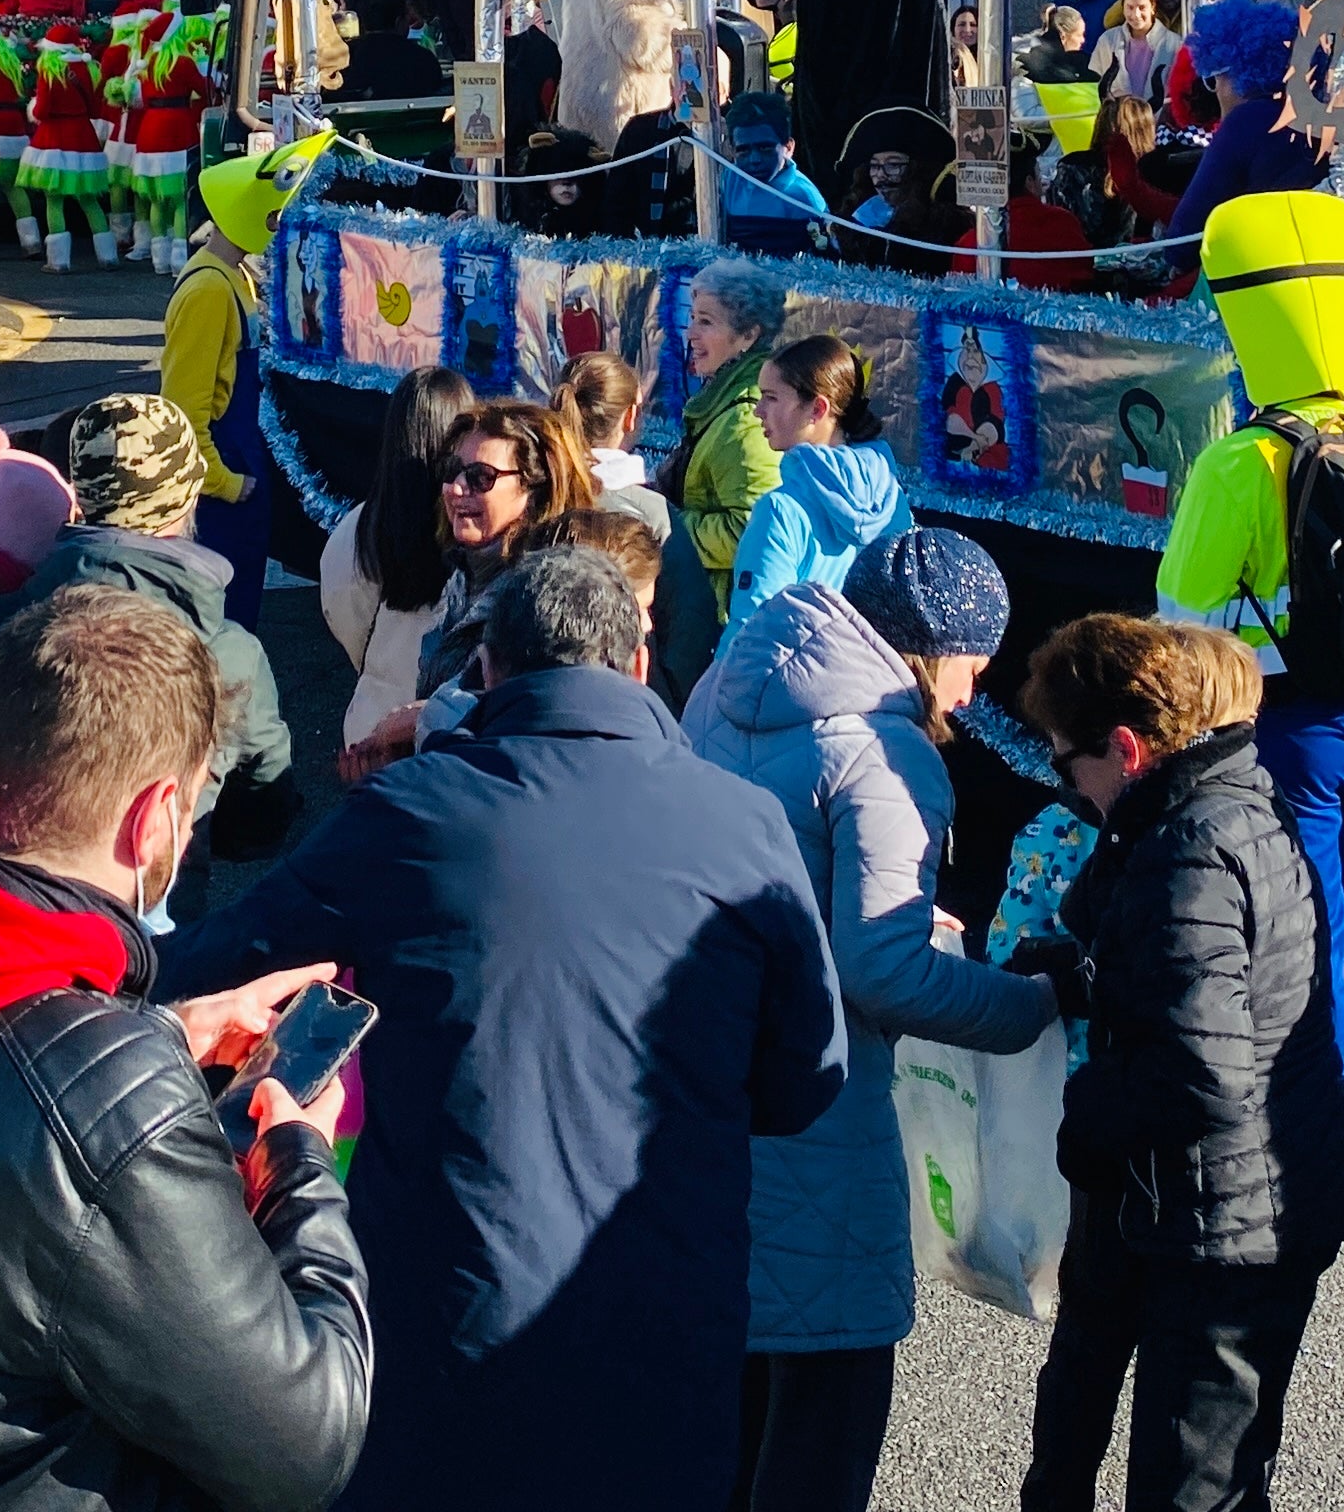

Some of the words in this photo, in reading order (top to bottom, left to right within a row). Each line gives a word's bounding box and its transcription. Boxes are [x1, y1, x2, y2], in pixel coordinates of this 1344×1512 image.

[459, 77, 497, 86] WANTED
[956, 89, 968, 107] SE
[971, 89, 1006, 107] BUSCA
